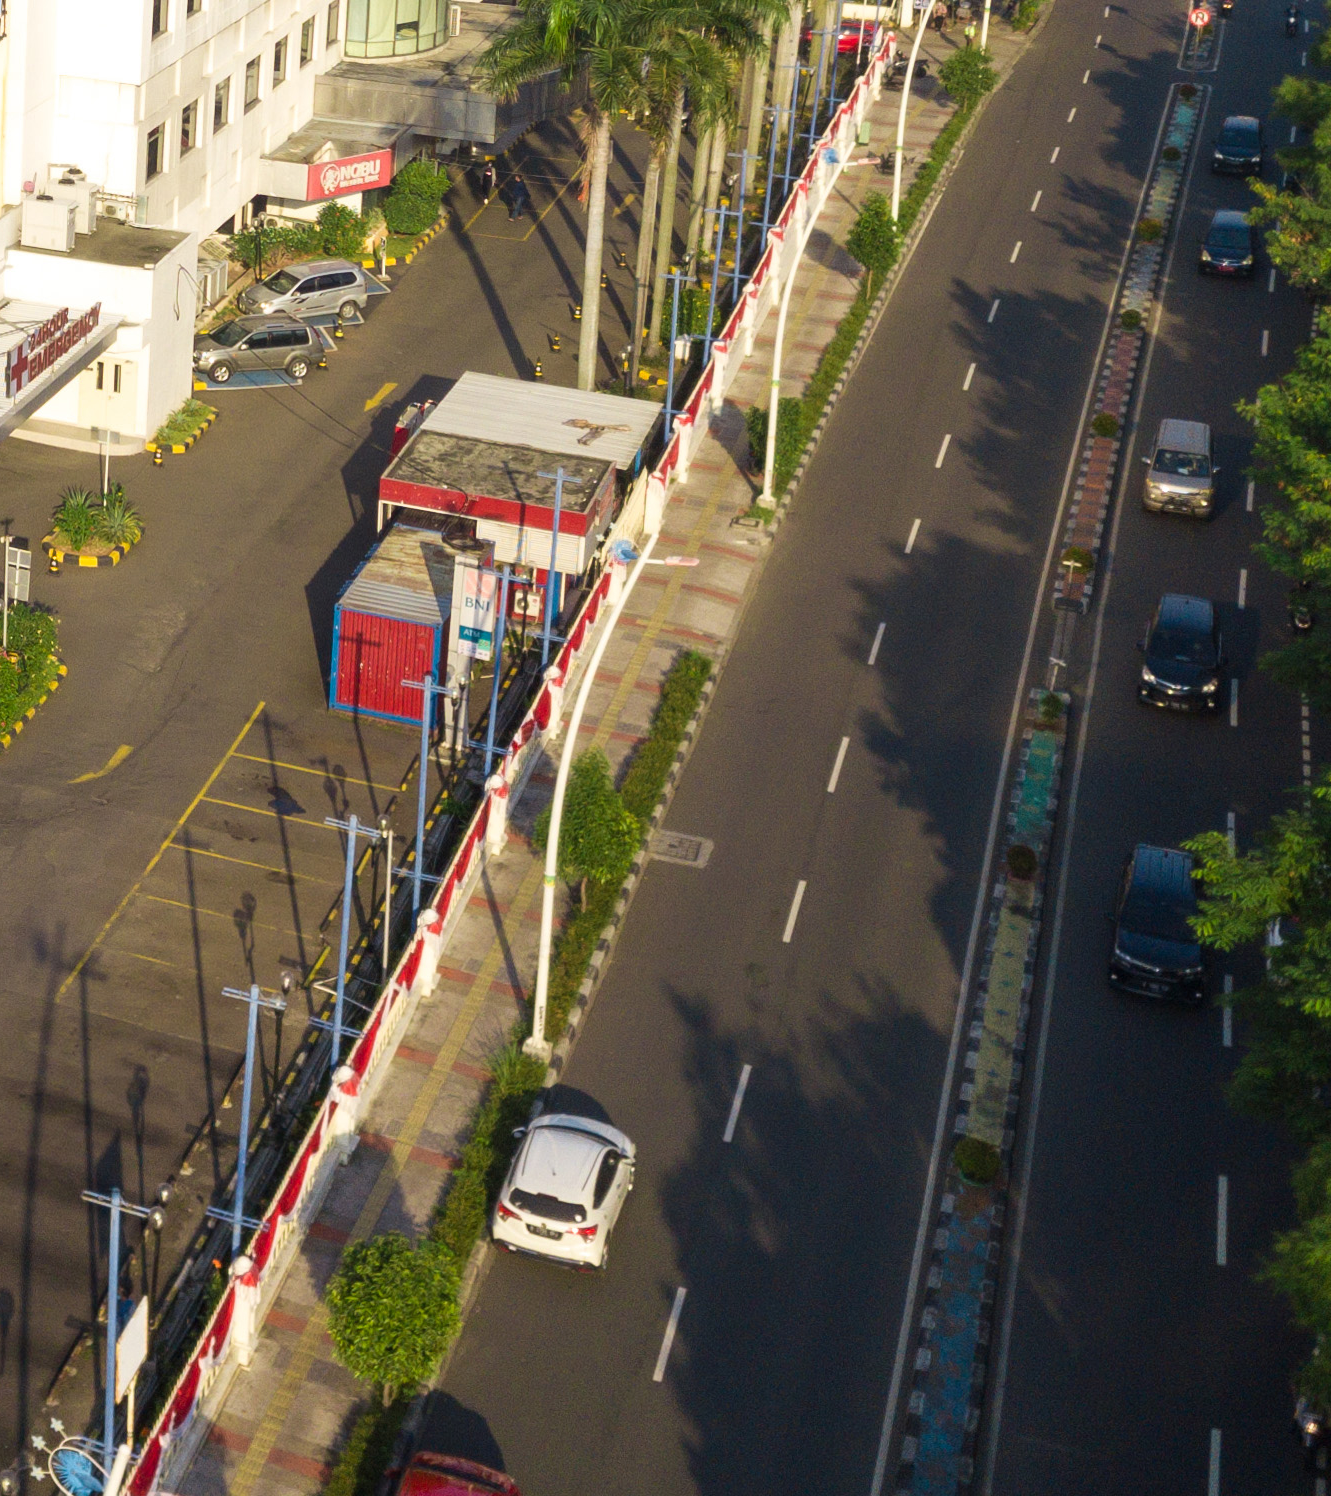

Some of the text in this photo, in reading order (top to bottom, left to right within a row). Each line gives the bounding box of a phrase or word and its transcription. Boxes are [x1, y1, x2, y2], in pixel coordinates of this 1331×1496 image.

[340, 159, 381, 181] NOBU
[28, 301, 102, 383] EMERGENCY
[465, 597, 490, 612] BNI
[463, 628, 481, 638] ATM
